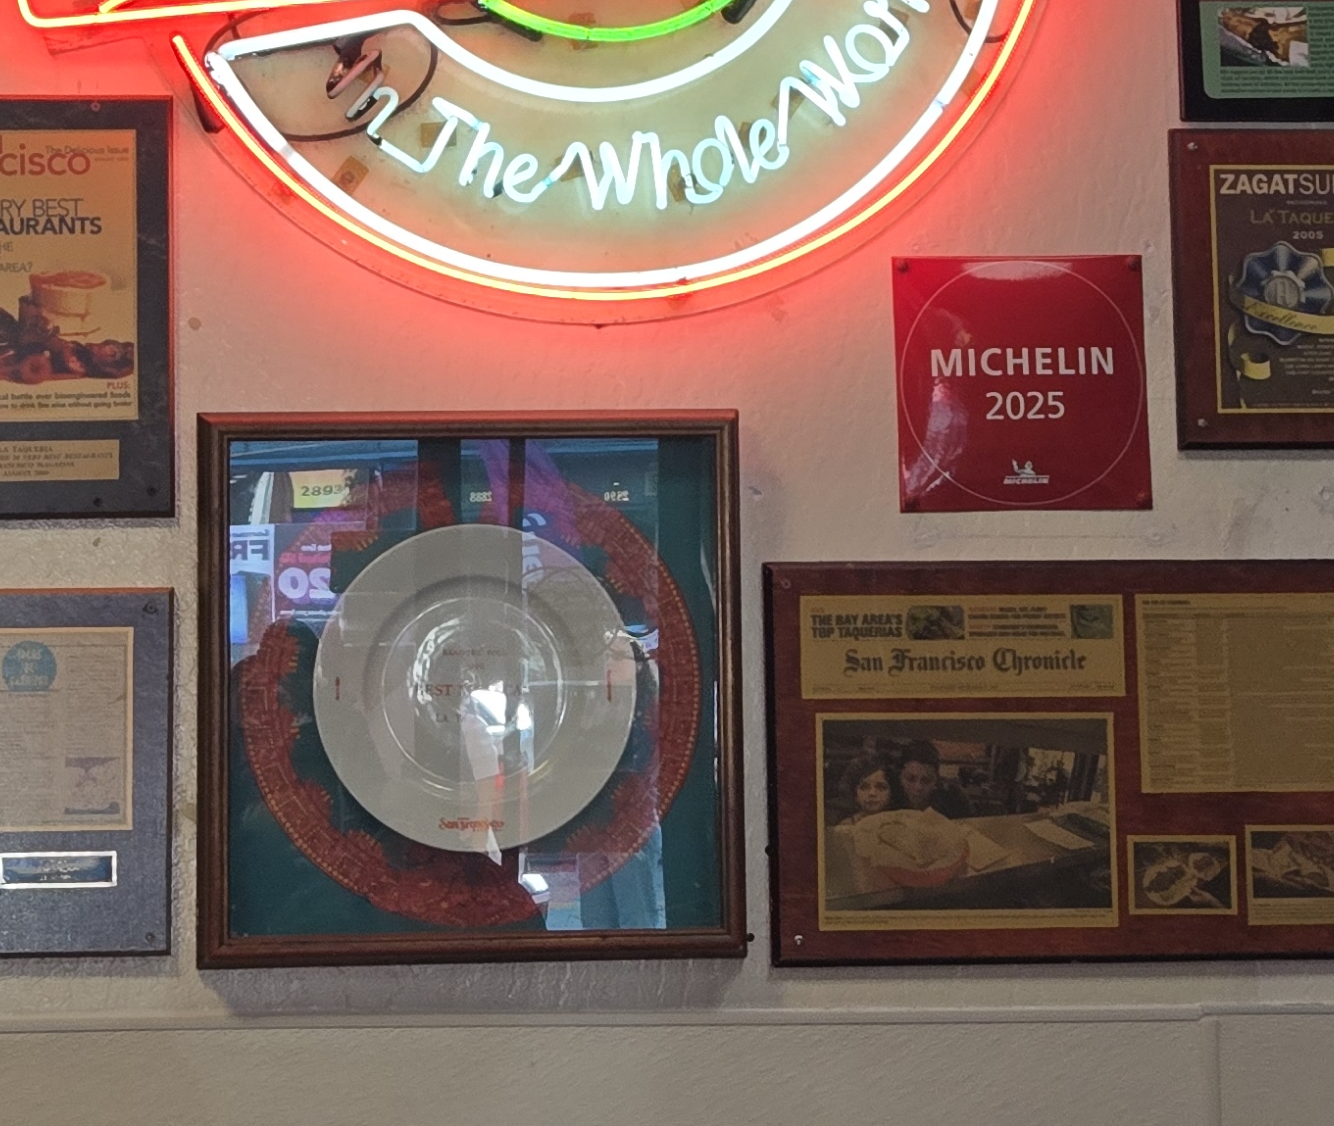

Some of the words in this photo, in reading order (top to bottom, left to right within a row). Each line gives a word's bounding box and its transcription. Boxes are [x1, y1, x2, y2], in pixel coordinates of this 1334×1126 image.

[45, 145, 63, 155] The
[64, 145, 106, 155] Delicious
[107, 145, 130, 155] Issue
[419, 96, 546, 204] The
[553, 113, 789, 211] Whole
[32, 197, 84, 218] BEST
[1250, 209, 1274, 224] LA
[1292, 230, 1324, 240] 2005
[930, 346, 1115, 377] MICHELIN
[106, 381, 131, 390] PLUS:
[985, 391, 1066, 420] 2025
[810, 613, 833, 626] THE
[835, 613, 859, 625] BAY
[861, 613, 903, 626] AREA'S
[812, 626, 835, 639] TOP
[837, 626, 903, 641] TAQUERIAS
[843, 648, 884, 678] San
[888, 647, 985, 677] Francisco
[992, 647, 1087, 676] Chronicle
